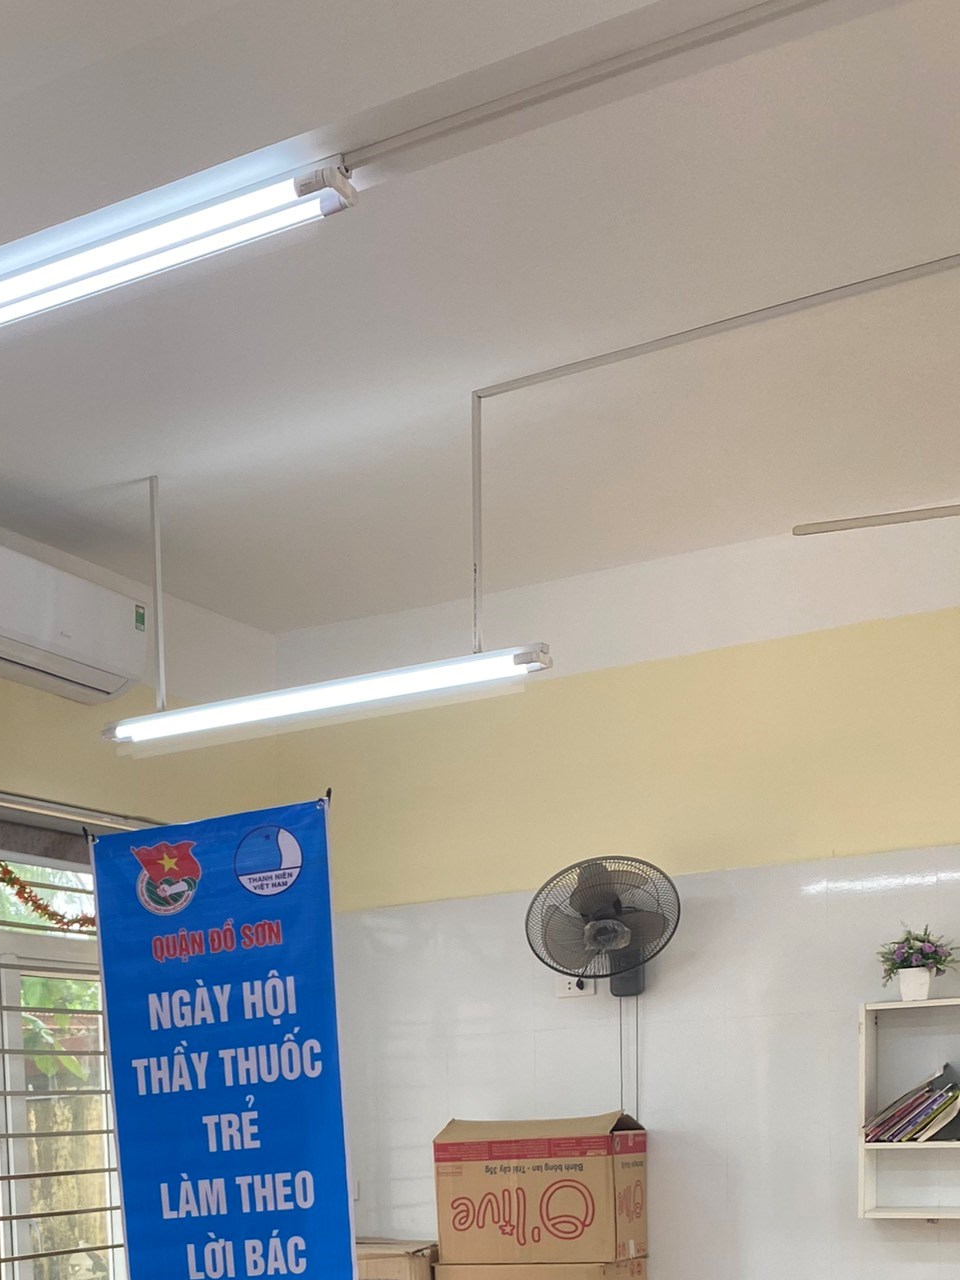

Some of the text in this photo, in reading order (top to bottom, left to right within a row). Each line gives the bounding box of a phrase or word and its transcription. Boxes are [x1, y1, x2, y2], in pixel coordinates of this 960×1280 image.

[248, 871, 293, 884] THANH NIÊN
[253, 881, 288, 891] VIỆT NAM
[152, 918, 282, 963] QUẬN ĐỒ SƠN
[148, 969, 297, 1031] NGÀY HỘI
[132, 1027, 322, 1096] THẦY THUỐC
[202, 1095, 261, 1152] TRẺ
[531, 1164, 543, 1173] lan
[160, 1170, 315, 1220] LÀM THEO
[451, 1179, 595, 1246] O'live
[186, 1229, 307, 1280] LỜI BÁC
